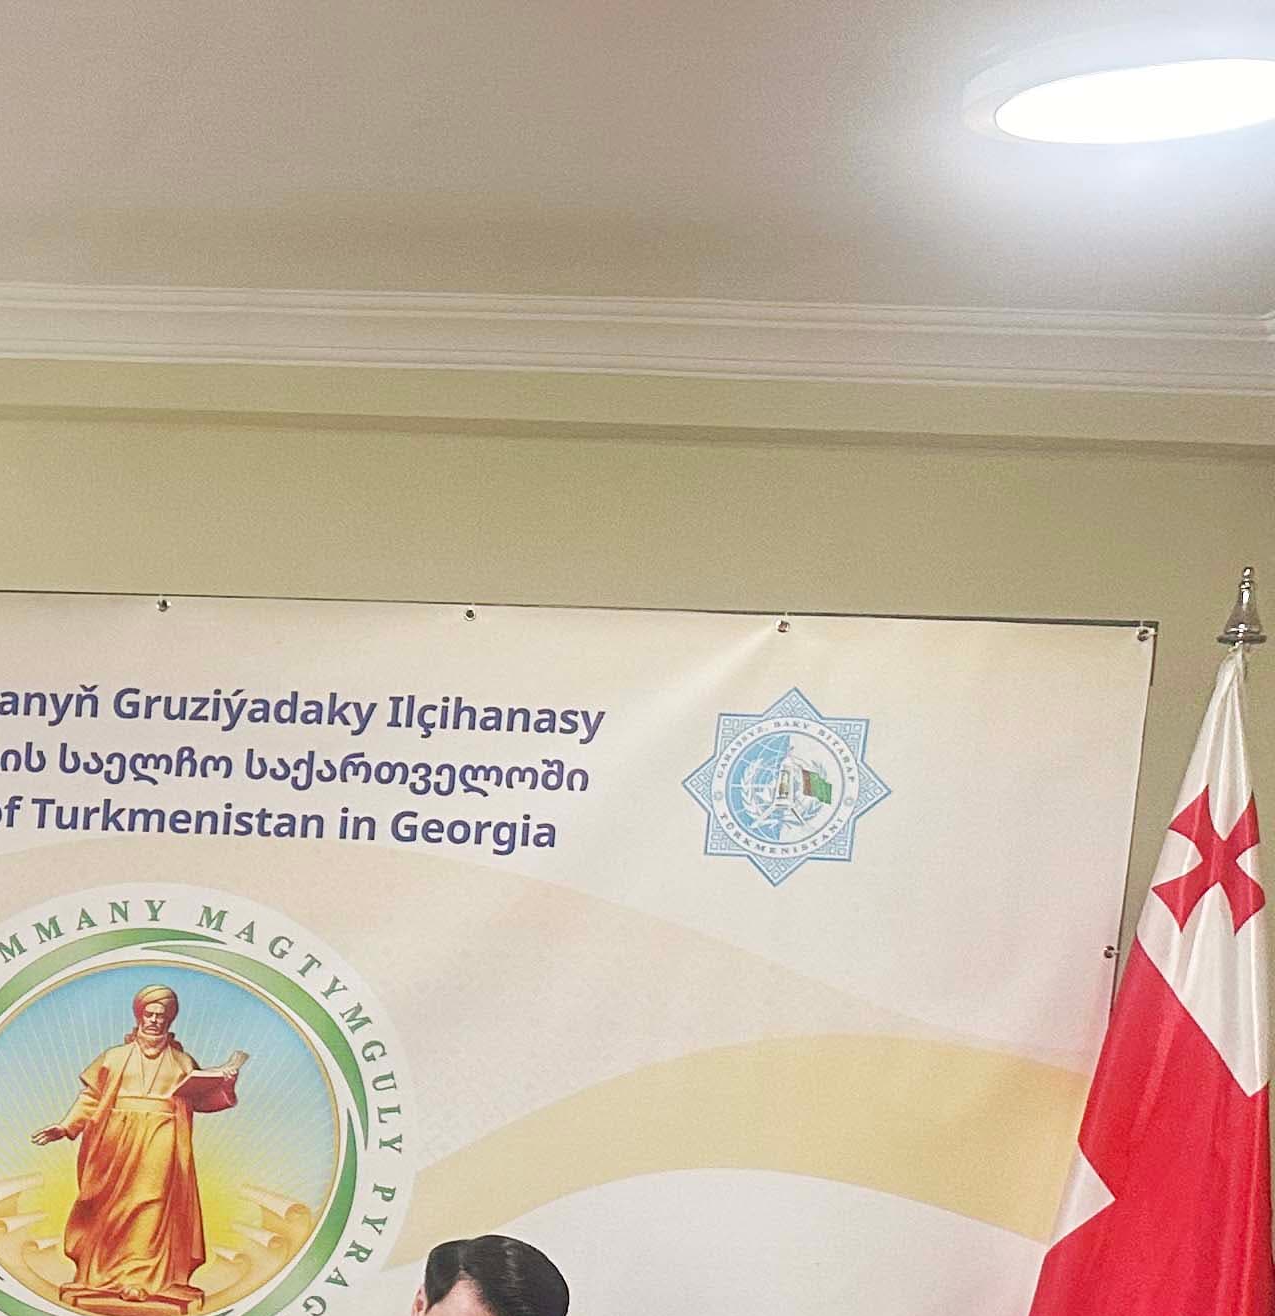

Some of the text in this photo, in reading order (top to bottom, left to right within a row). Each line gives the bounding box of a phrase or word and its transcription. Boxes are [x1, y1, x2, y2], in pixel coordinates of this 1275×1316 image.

[113, 687, 377, 736] Gruziýadaky
[386, 694, 606, 744] Ilçihanasy
[58, 742, 233, 787] საელჩო
[244, 747, 589, 797] საქართველოში
[30, 797, 325, 840] Turkmenistan
[338, 806, 377, 841] in
[390, 810, 557, 857] Georgia
[195, 904, 403, 1155] MAGTYMGULY
